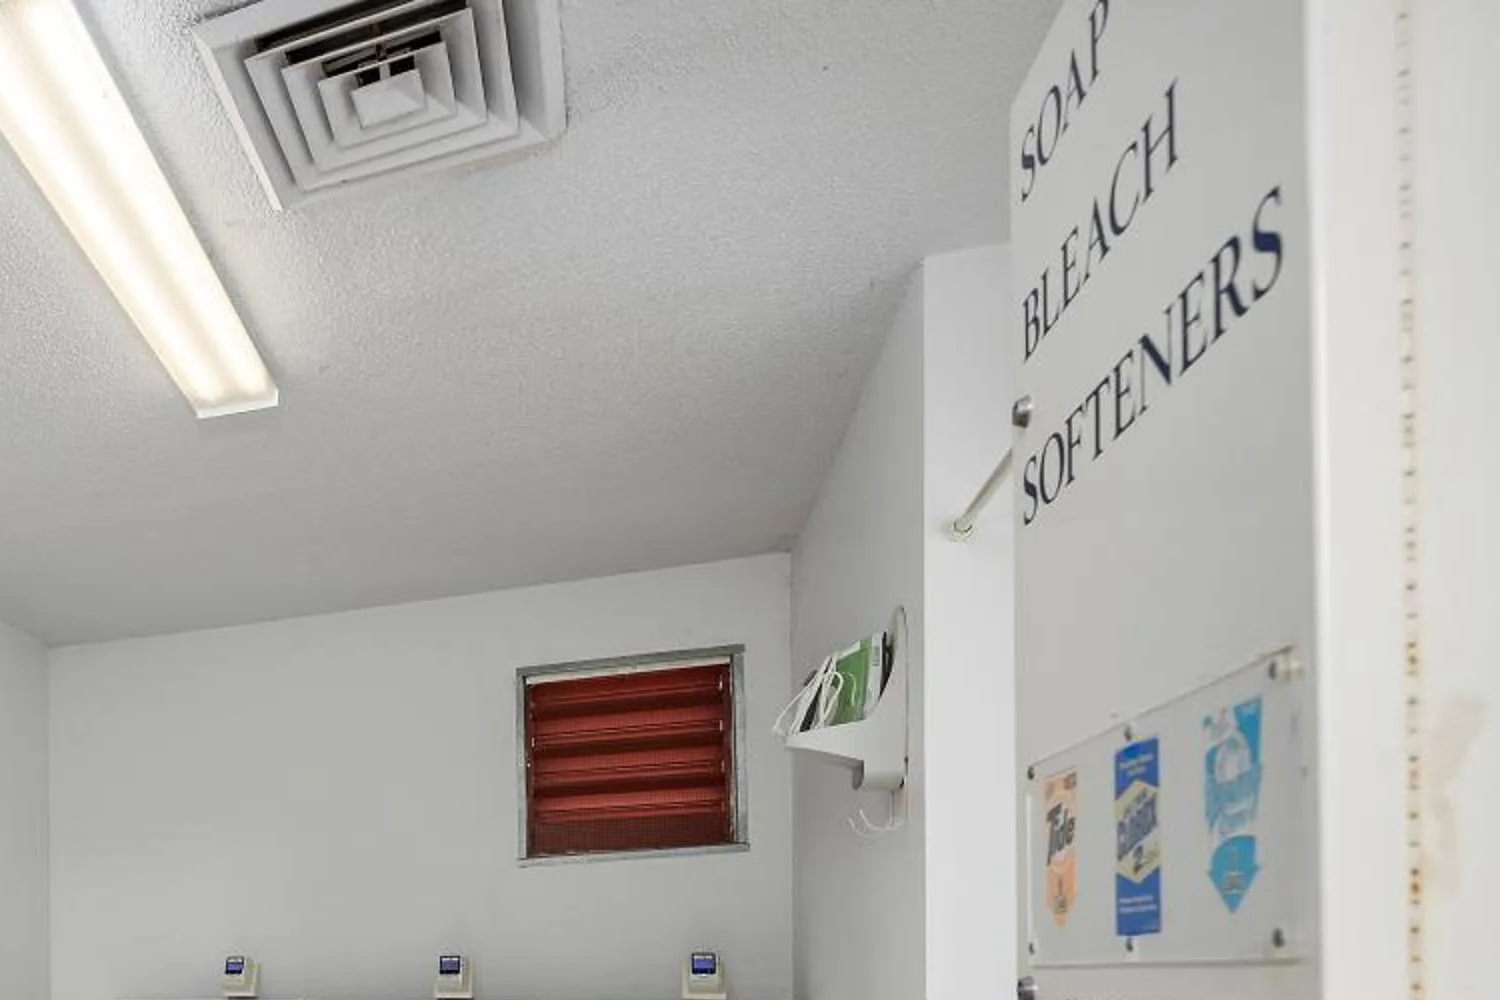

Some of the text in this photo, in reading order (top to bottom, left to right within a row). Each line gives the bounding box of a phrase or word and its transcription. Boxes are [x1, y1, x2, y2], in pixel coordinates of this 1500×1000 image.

[1019, 0, 1111, 203] SOAP
[1023, 76, 1179, 364] BLEACH
[1022, 184, 1284, 527] SOFTENERS
